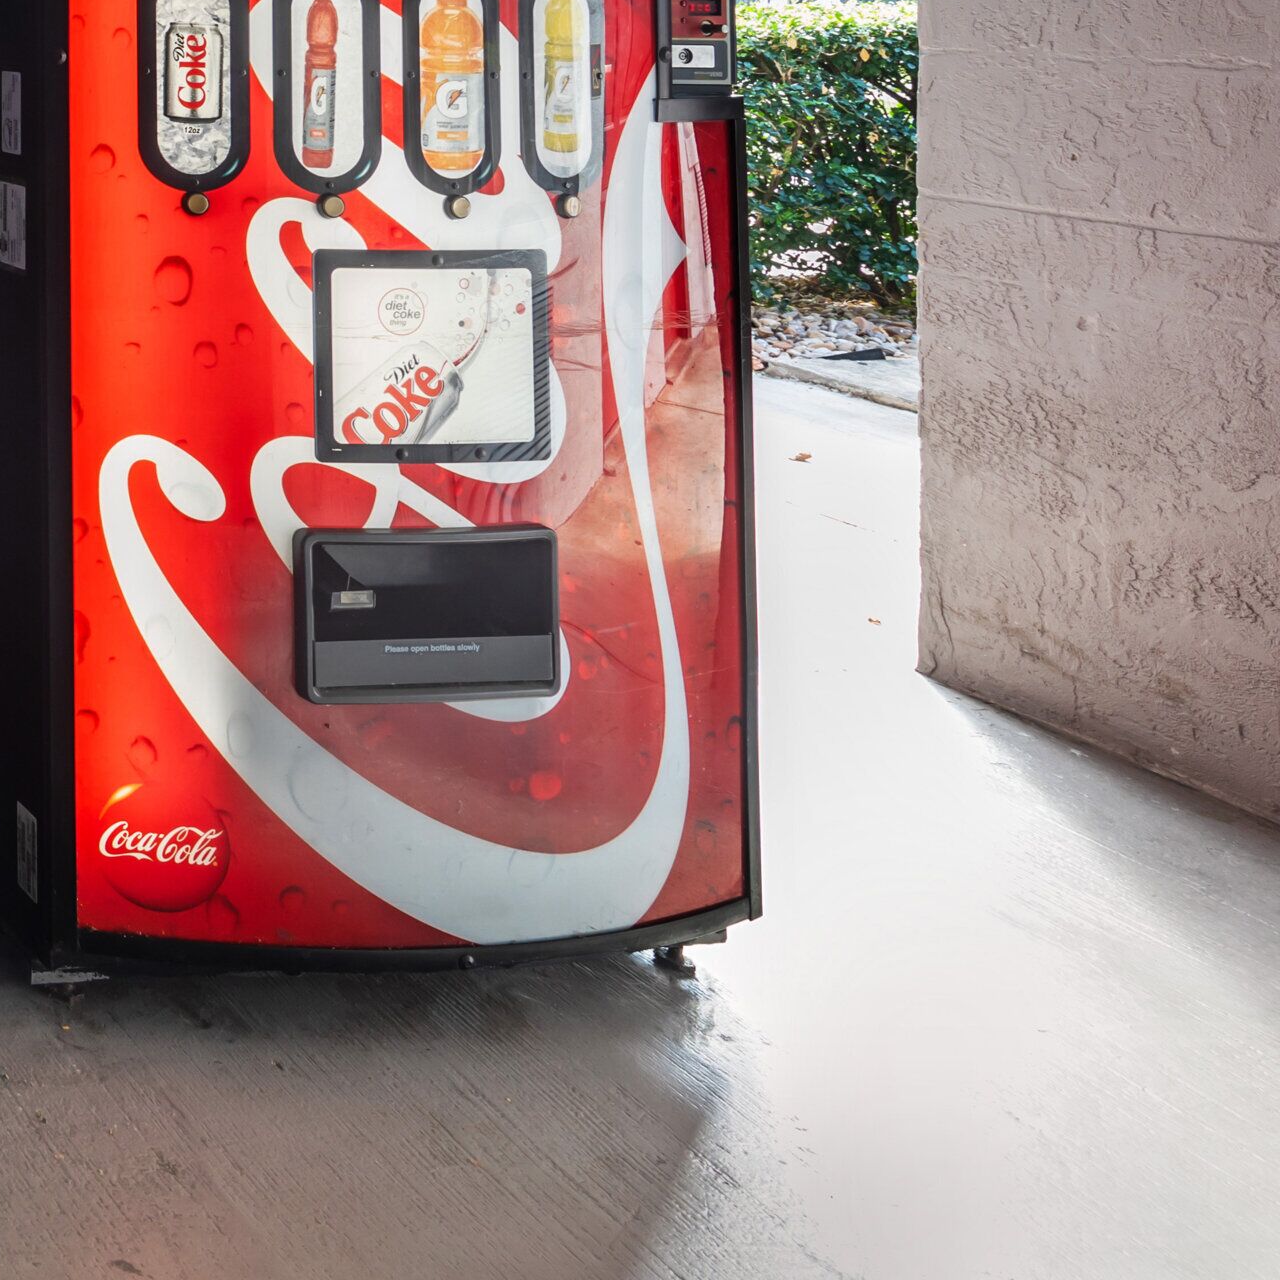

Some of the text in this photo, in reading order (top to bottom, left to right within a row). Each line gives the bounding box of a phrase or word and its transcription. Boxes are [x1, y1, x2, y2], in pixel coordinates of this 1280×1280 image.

[172, 32, 185, 62] Diet
[177, 34, 207, 110] Coke
[310, 76, 327, 116] G
[435, 80, 468, 119] G
[184, 126, 201, 134] 12oz
[385, 300, 407, 311] diet
[393, 308, 421, 320] coke
[389, 318, 407, 327] thing
[383, 354, 421, 384] Diet
[341, 365, 445, 444] Coke
[384, 642, 481, 653] Please open bottles slowly
[99, 821, 224, 867] Coca-Cola
